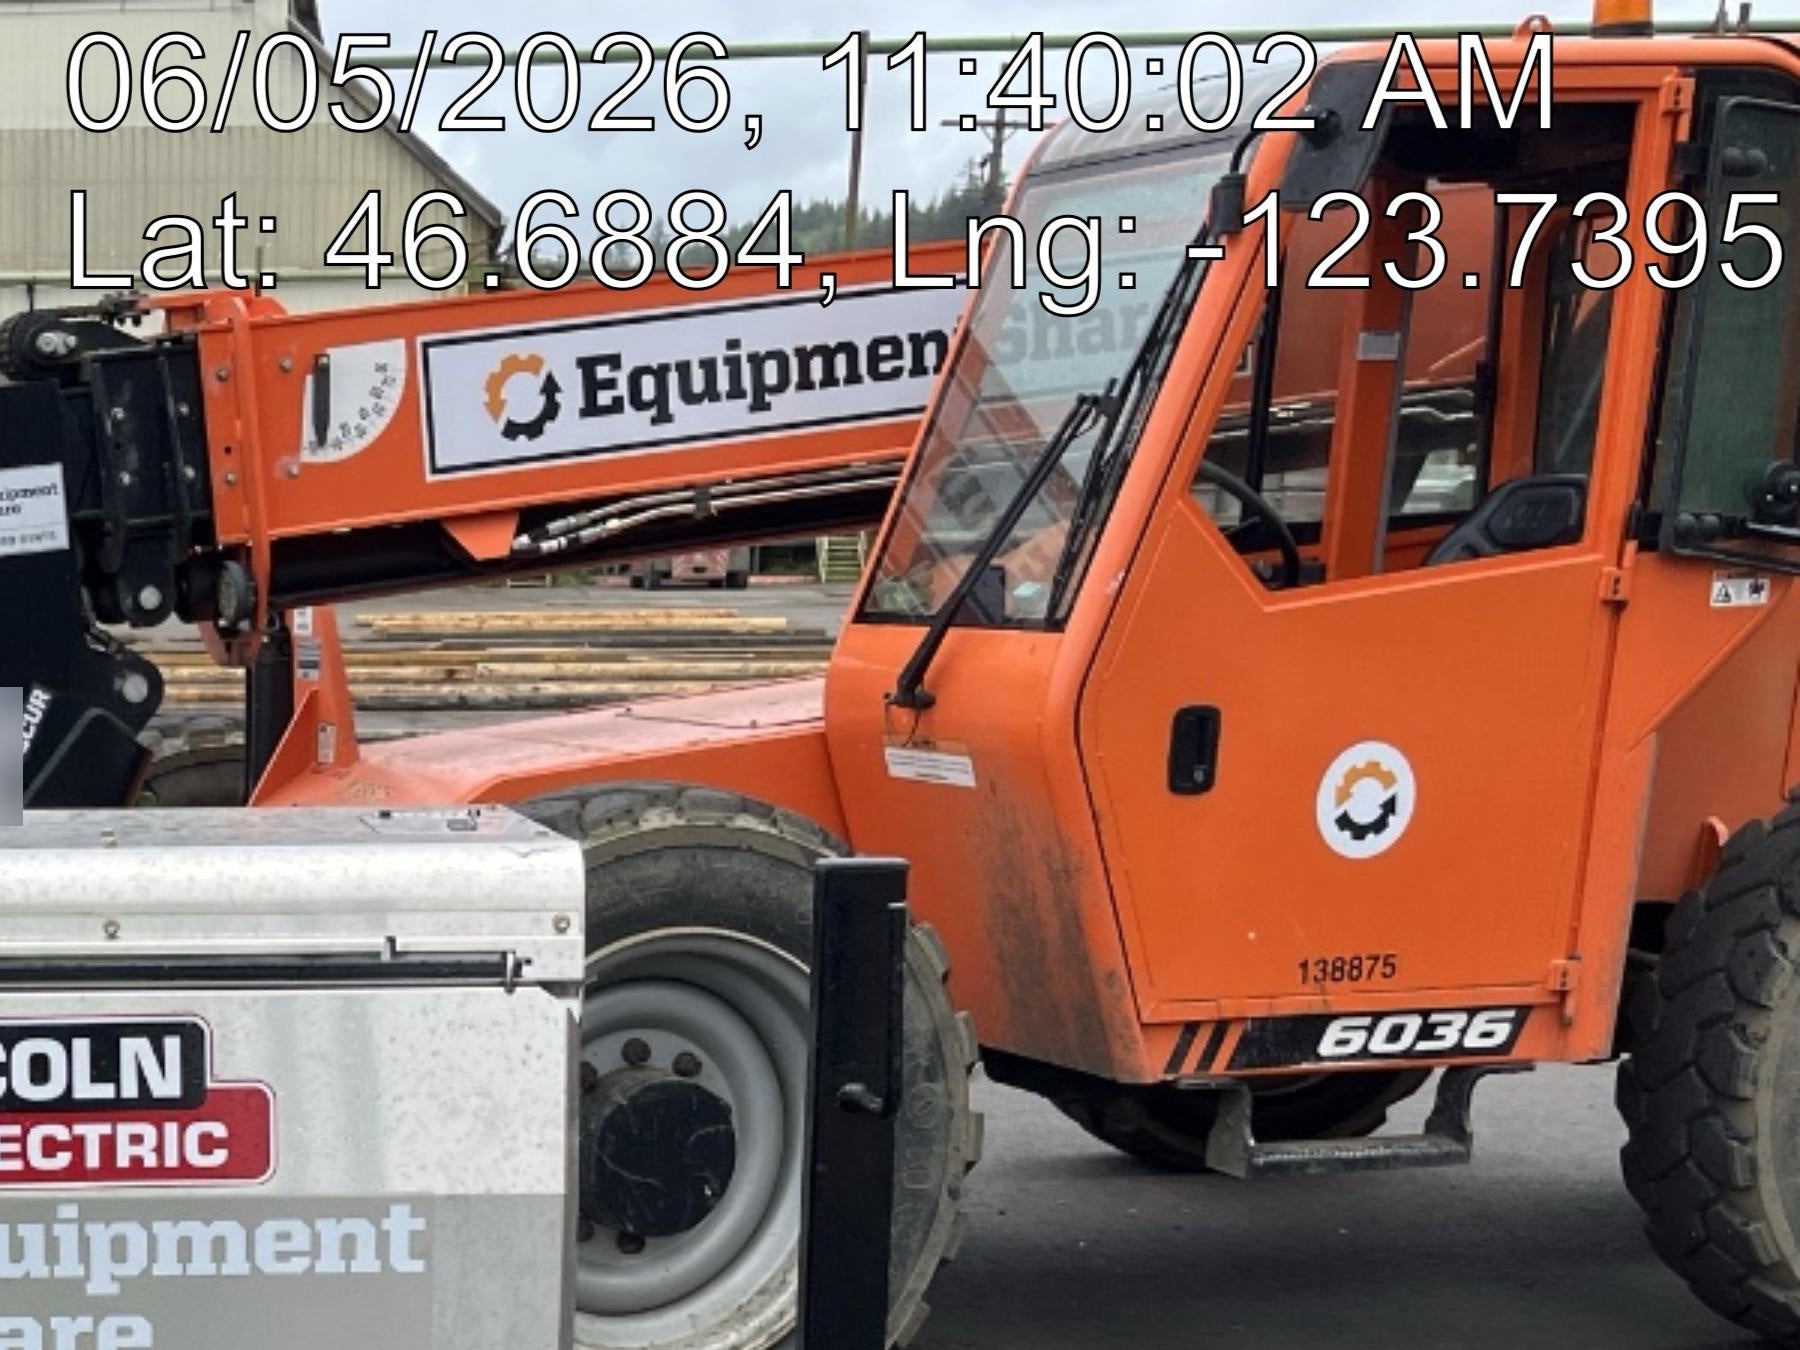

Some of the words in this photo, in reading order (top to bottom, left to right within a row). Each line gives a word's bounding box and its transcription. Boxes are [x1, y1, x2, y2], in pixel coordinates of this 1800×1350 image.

[576, 324, 962, 426] Equipmen
[1298, 954, 1397, 984] 138875
[1317, 1009, 1517, 1057] 6036
